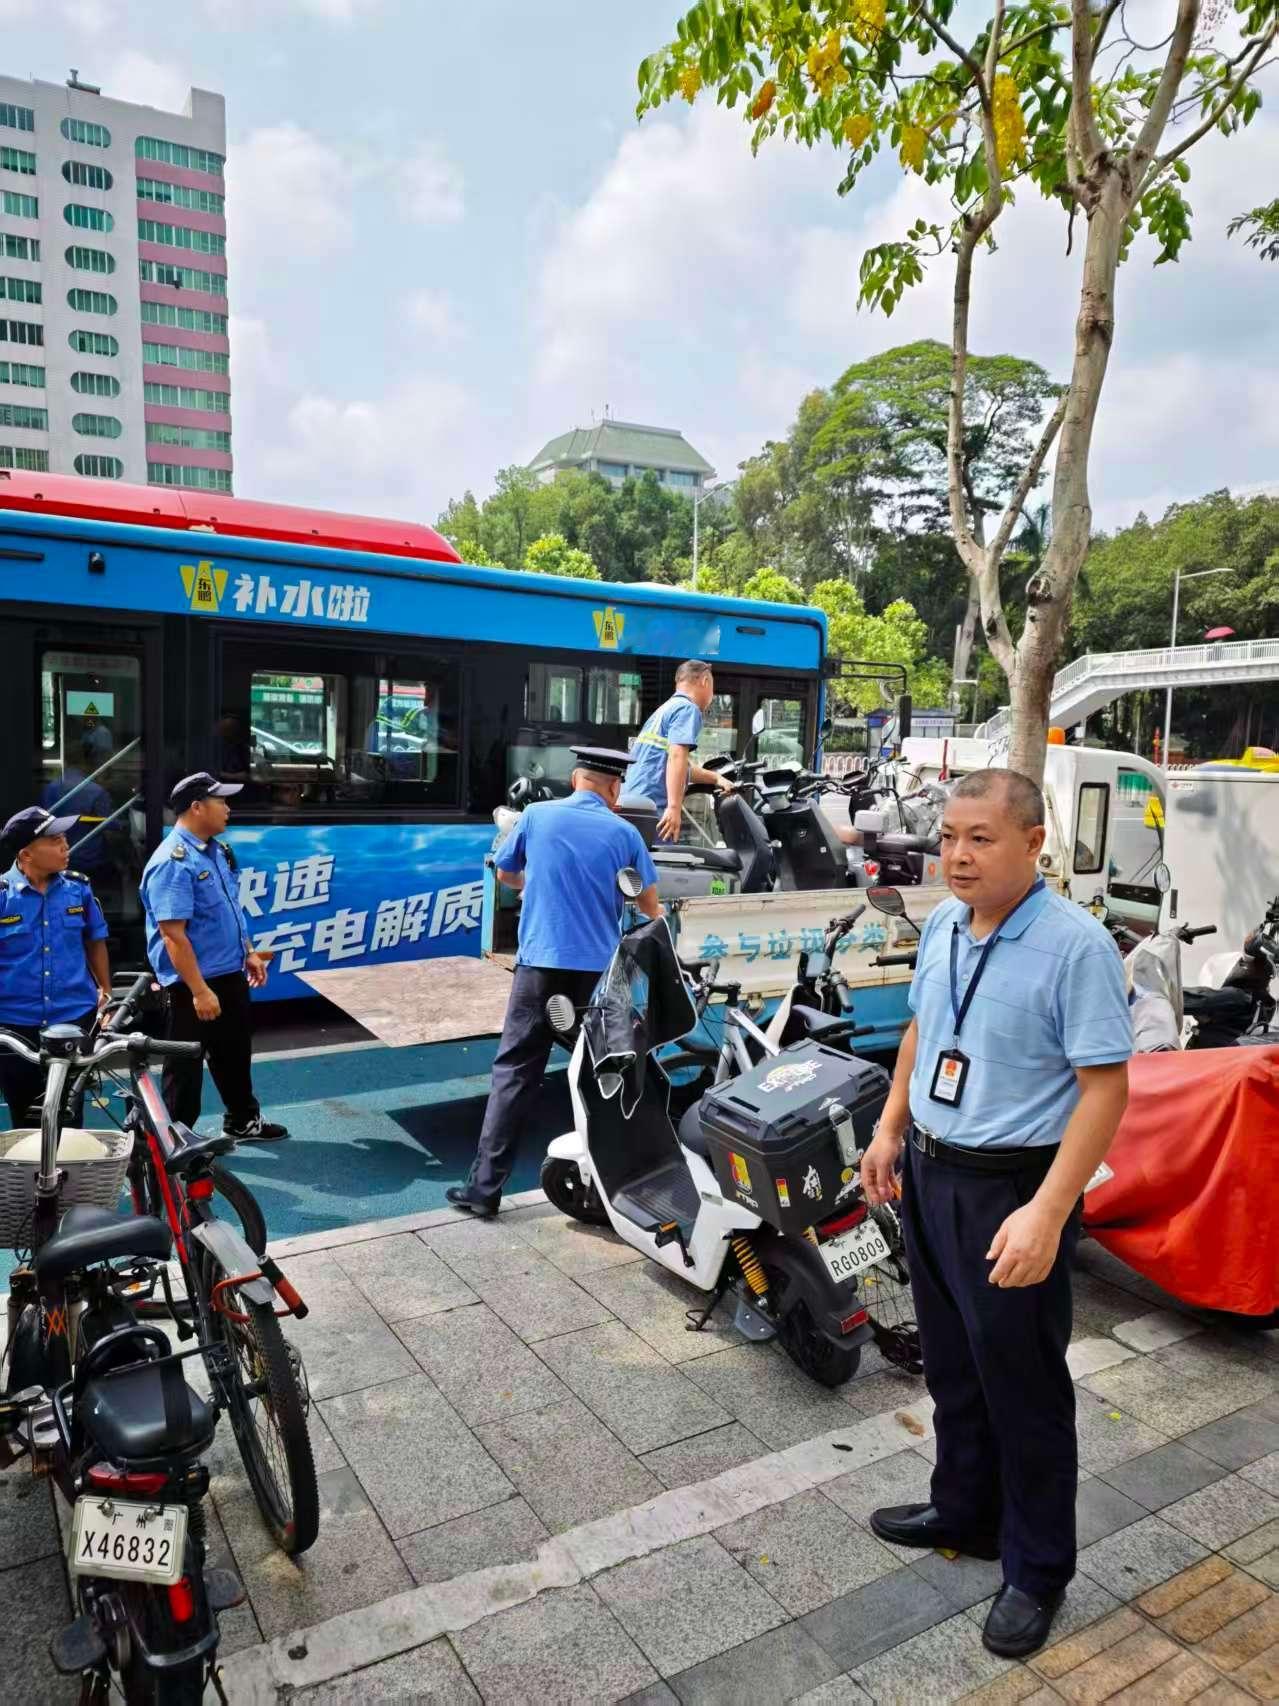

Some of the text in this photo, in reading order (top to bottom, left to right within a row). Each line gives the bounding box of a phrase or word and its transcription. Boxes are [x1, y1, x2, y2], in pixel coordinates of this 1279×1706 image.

[233, 573, 370, 623] 补水啦
[251, 880, 484, 974] 充电解质
[830, 1237, 885, 1277] RG0809
[81, 1530, 171, 1567] X46832
